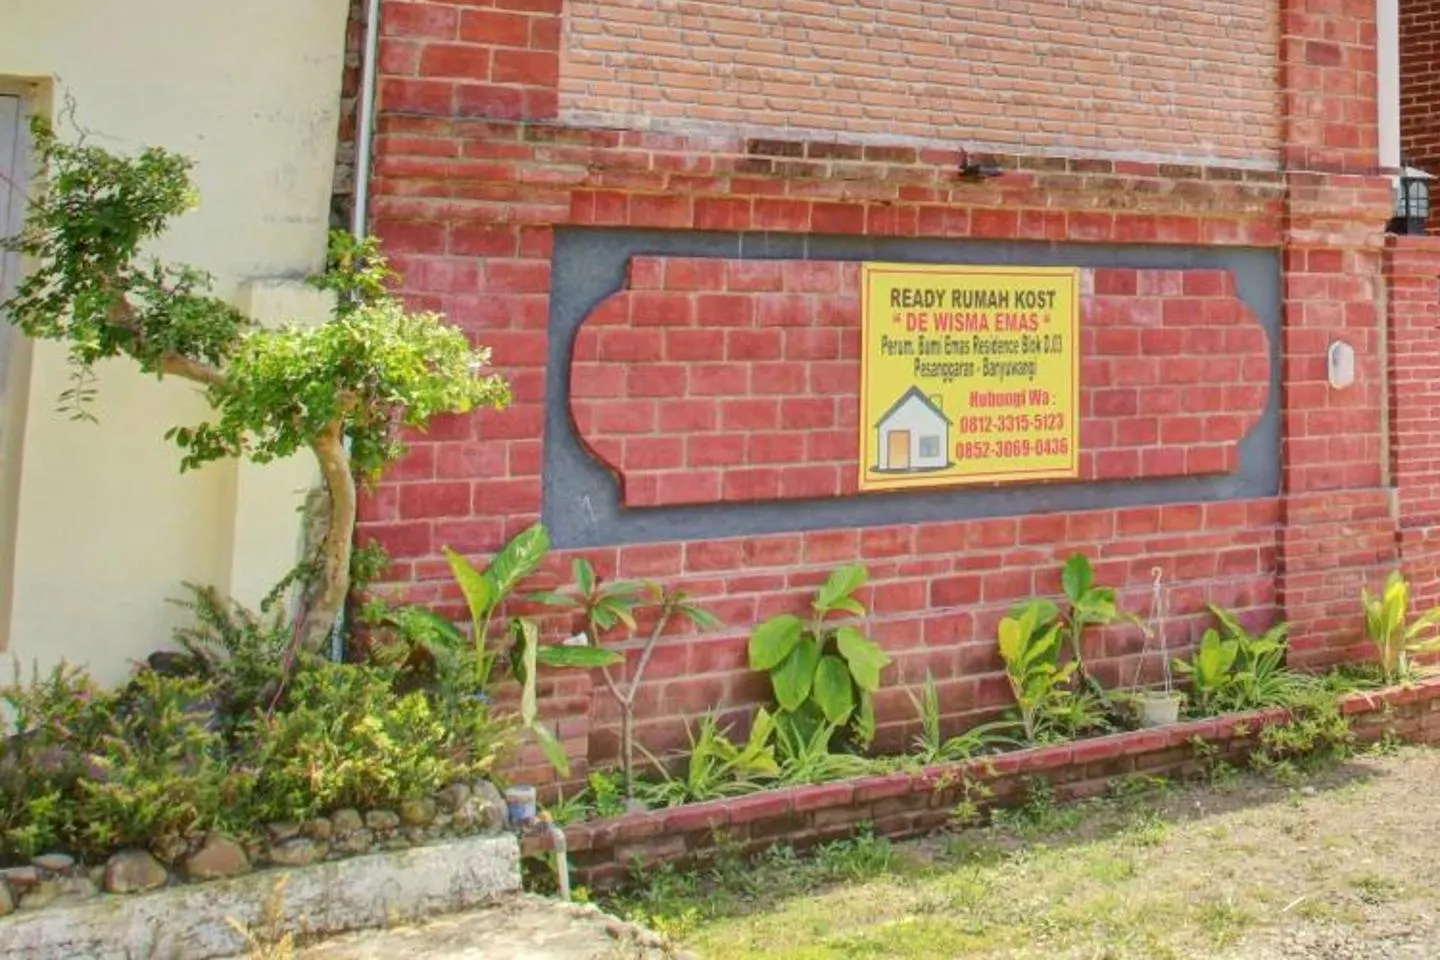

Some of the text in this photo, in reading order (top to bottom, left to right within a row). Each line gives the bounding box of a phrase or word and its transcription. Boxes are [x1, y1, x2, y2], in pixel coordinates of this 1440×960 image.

[890, 288, 1057, 309] READY RUMAH KOST
[906, 312, 928, 332] DE
[933, 312, 990, 333] WISMA
[995, 313, 1039, 333] EMAS
[918, 334, 942, 356] Bumi
[944, 334, 970, 356] Emas
[972, 334, 1020, 355] Residence
[913, 356, 975, 383] Pesanggaran
[982, 355, 1037, 383] Banyuwangi
[969, 390, 1026, 408] Hubungi
[960, 411, 1065, 434] 0812-3315-5123
